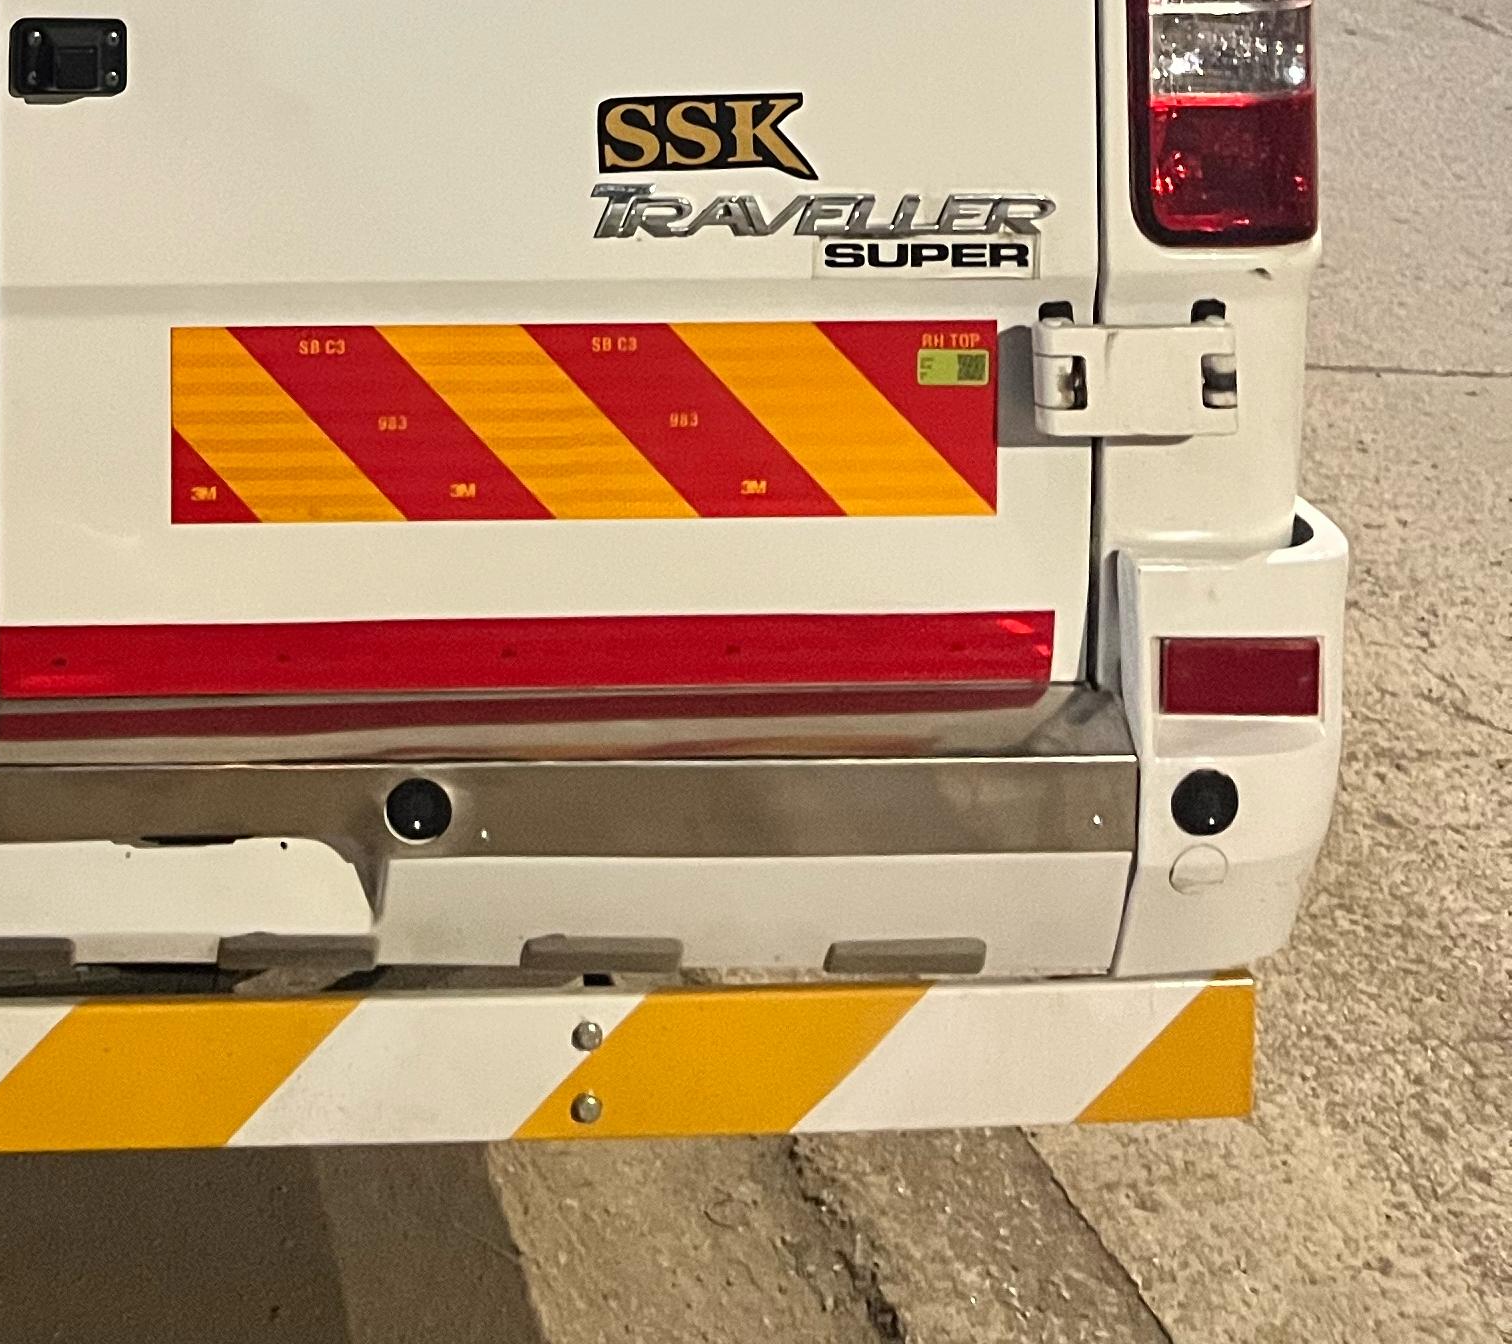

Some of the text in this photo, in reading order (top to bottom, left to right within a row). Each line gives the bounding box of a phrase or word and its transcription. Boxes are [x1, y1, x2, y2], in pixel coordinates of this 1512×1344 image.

[603, 98, 811, 175] SSK
[590, 182, 1057, 239] TRAVELLER
[823, 242, 1030, 268] SUPER
[325, 338, 345, 355] C3
[592, 336, 637, 352] SB C3
[922, 333, 980, 348] RH TOP
[190, 485, 218, 502] 3M
[449, 482, 476, 499] 3M
[740, 479, 767, 495] 3M
